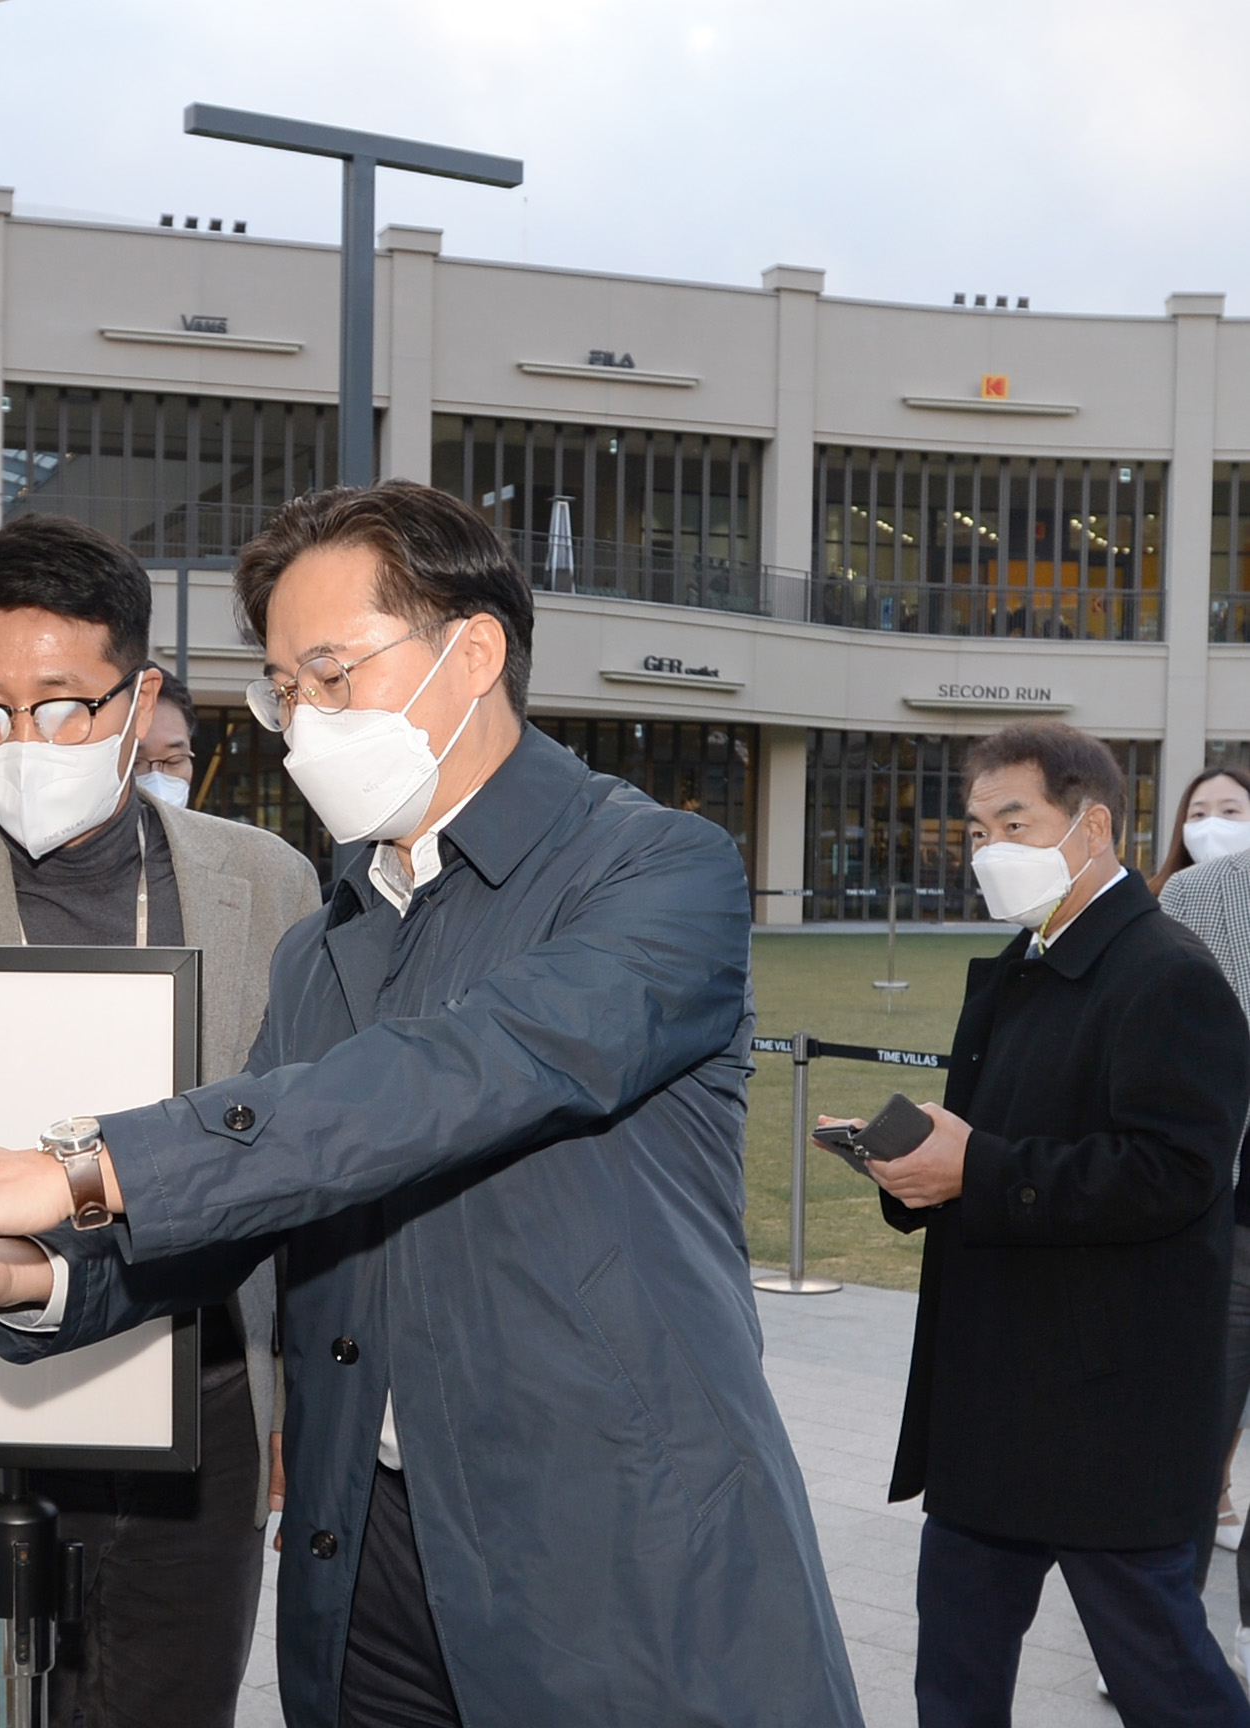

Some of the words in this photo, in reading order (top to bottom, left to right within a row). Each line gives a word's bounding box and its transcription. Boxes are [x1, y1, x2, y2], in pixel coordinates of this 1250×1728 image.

[938, 684, 1010, 699] SECOND
[1016, 687, 1051, 701] RUN
[754, 1039, 774, 1051] TIME
[775, 1040, 792, 1052] VILL
[877, 1050, 901, 1063] TIME
[902, 1052, 938, 1067] VILLAS
